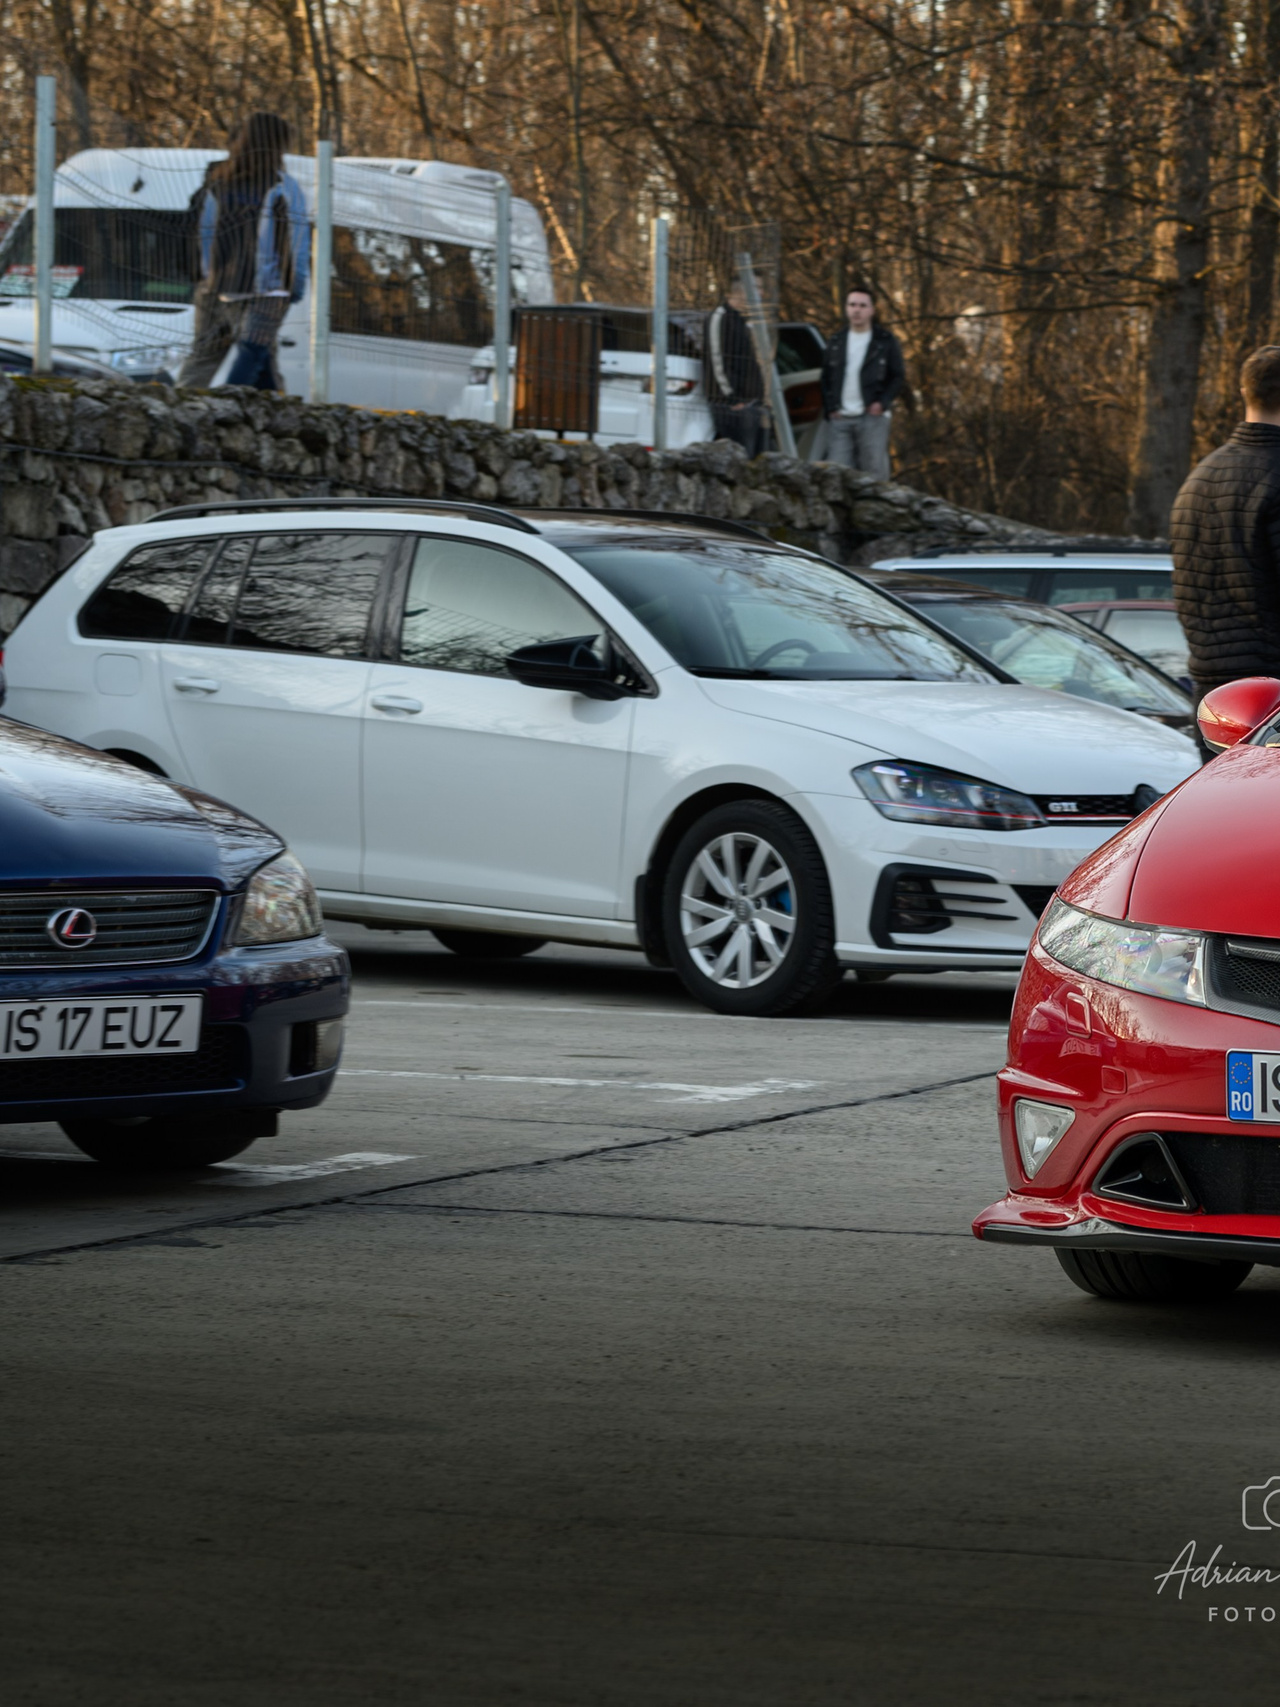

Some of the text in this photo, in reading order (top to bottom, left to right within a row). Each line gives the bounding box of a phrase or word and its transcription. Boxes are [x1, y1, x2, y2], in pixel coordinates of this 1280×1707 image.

[5, 1004, 185, 1053] IS 17 EUZ
[1231, 1091, 1252, 1112] RO
